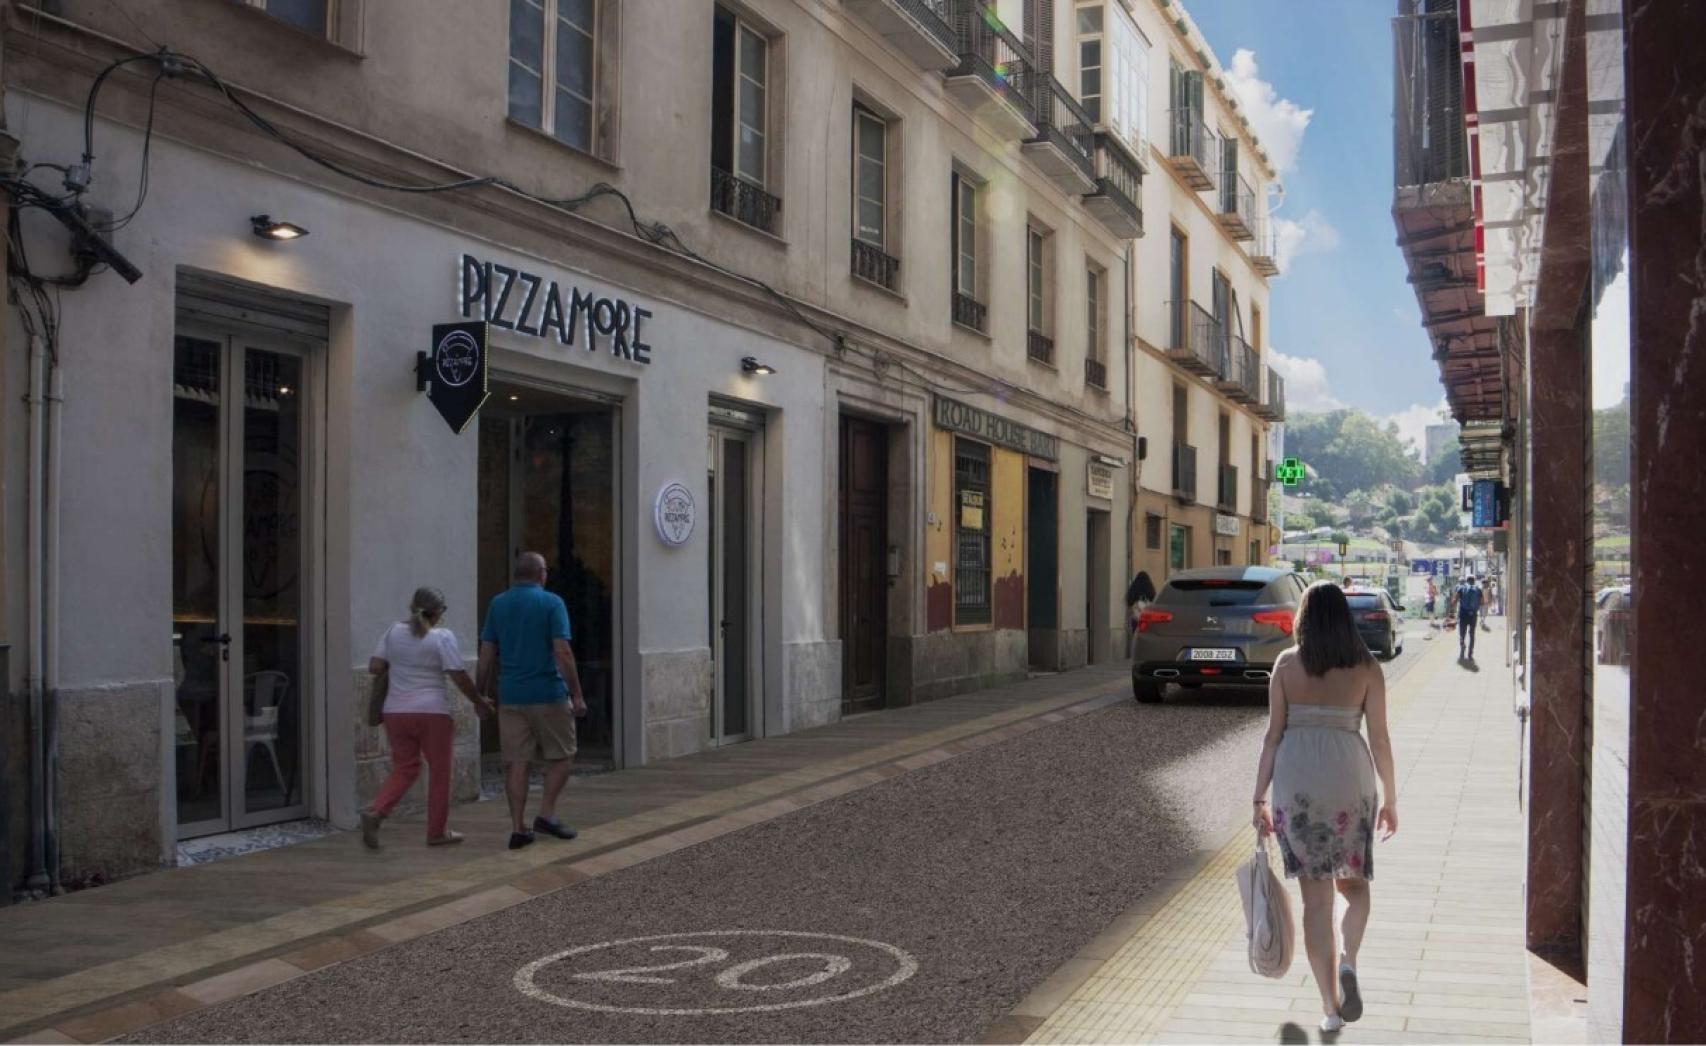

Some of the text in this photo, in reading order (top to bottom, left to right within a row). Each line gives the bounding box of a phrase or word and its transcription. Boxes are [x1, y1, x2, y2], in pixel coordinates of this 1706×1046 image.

[460, 254, 653, 365] PIZZAMORE
[939, 399, 980, 432] ROAD
[986, 414, 1024, 450] HOUSE
[571, 944, 852, 991] 20
